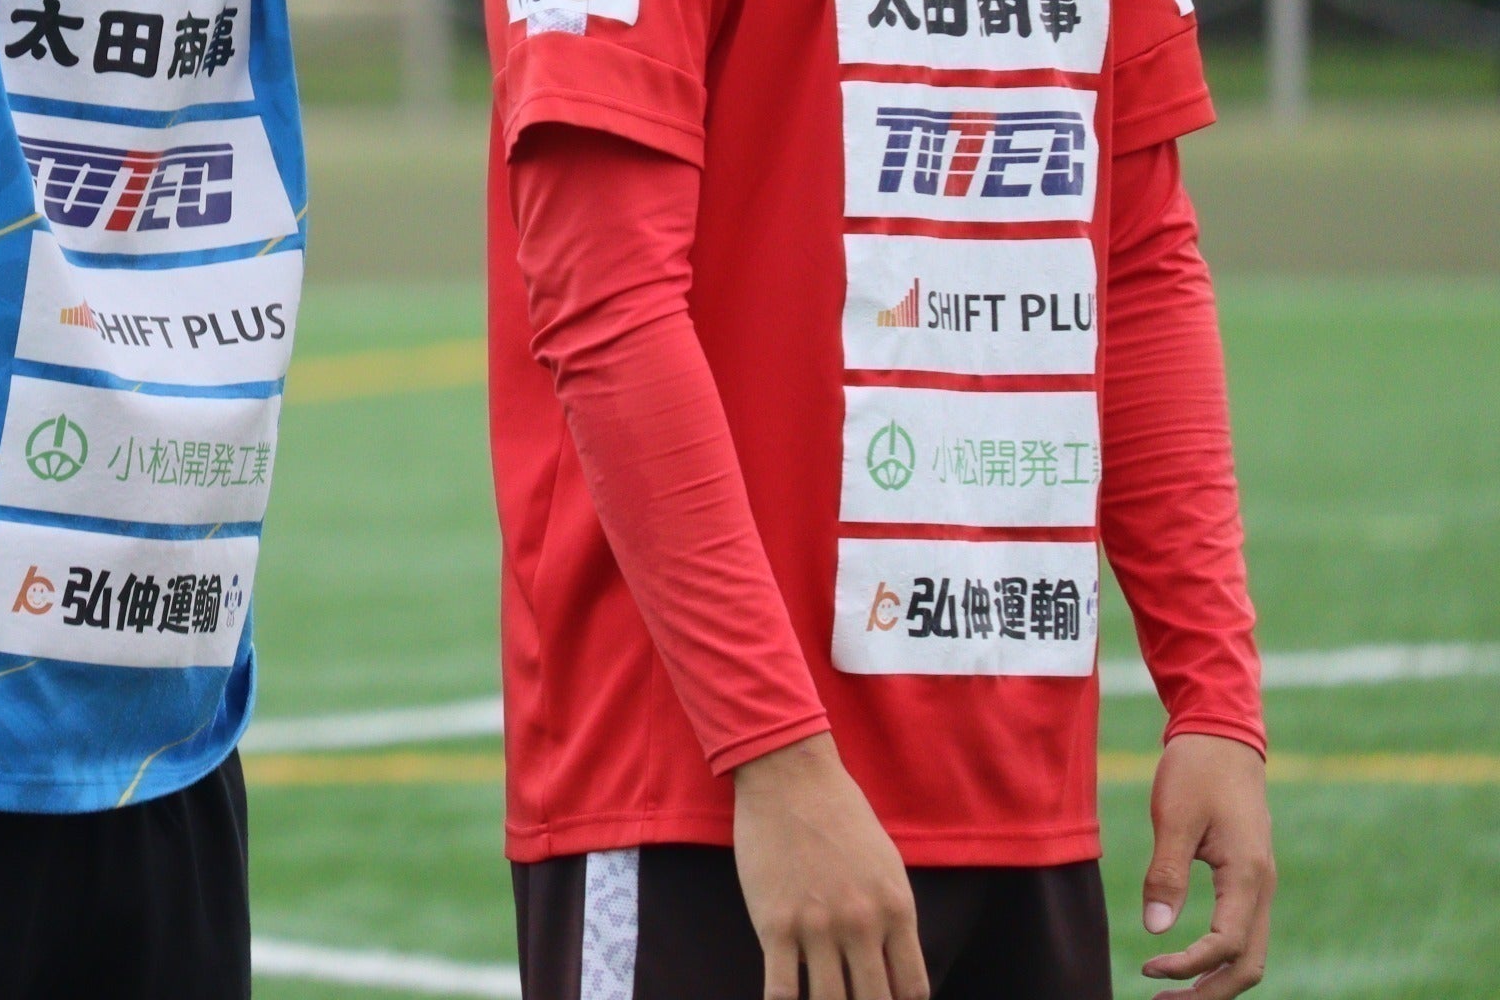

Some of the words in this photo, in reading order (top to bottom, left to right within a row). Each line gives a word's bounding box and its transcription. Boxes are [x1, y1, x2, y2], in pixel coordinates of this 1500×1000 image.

[876, 107, 1086, 198] TOTEC
[182, 303, 286, 349] PLUS
[927, 290, 1006, 332] SHIFT
[1020, 292, 1096, 332] PLU
[107, 436, 271, 488] 小松開発工業
[61, 567, 222, 634] 弘伸運輸
[906, 577, 1081, 641] 弘伸運輸
